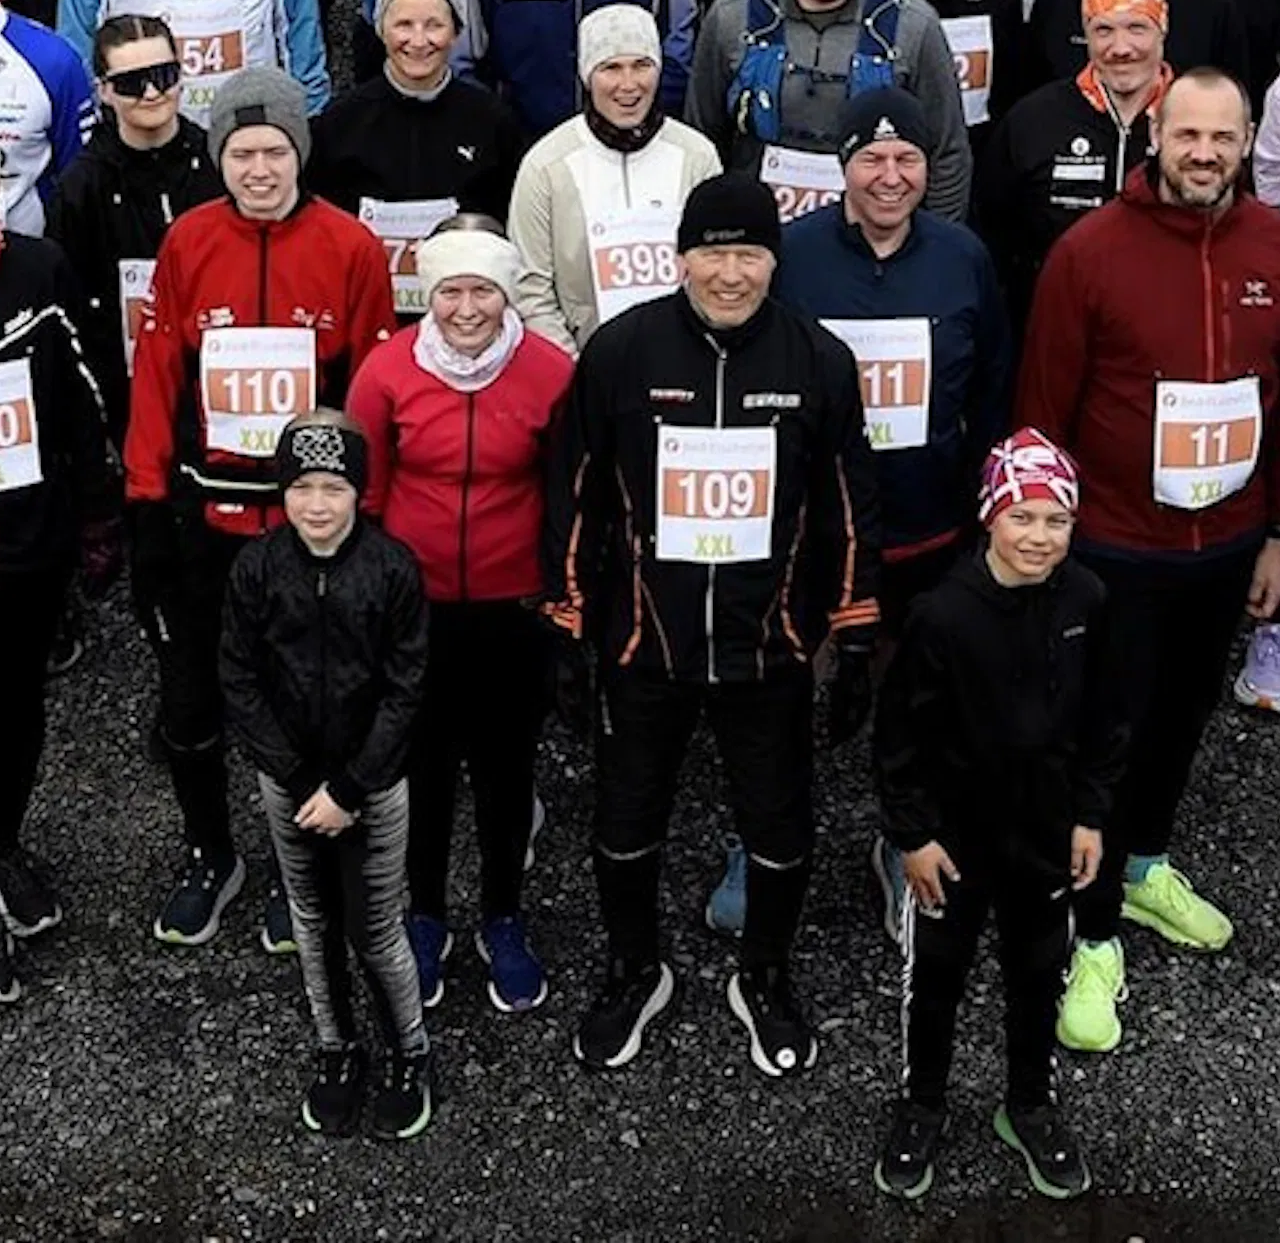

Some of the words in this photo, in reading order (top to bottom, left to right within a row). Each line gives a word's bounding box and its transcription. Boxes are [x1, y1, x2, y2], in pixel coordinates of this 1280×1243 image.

[182, 38, 224, 75] 54
[186, 87, 216, 106] XX
[609, 243, 679, 287] 398
[222, 372, 295, 413] 110
[863, 363, 904, 406] 11
[868, 421, 896, 443] XL
[1190, 425, 1230, 466] 11
[679, 474, 756, 518] 109
[694, 534, 734, 556] XXL
